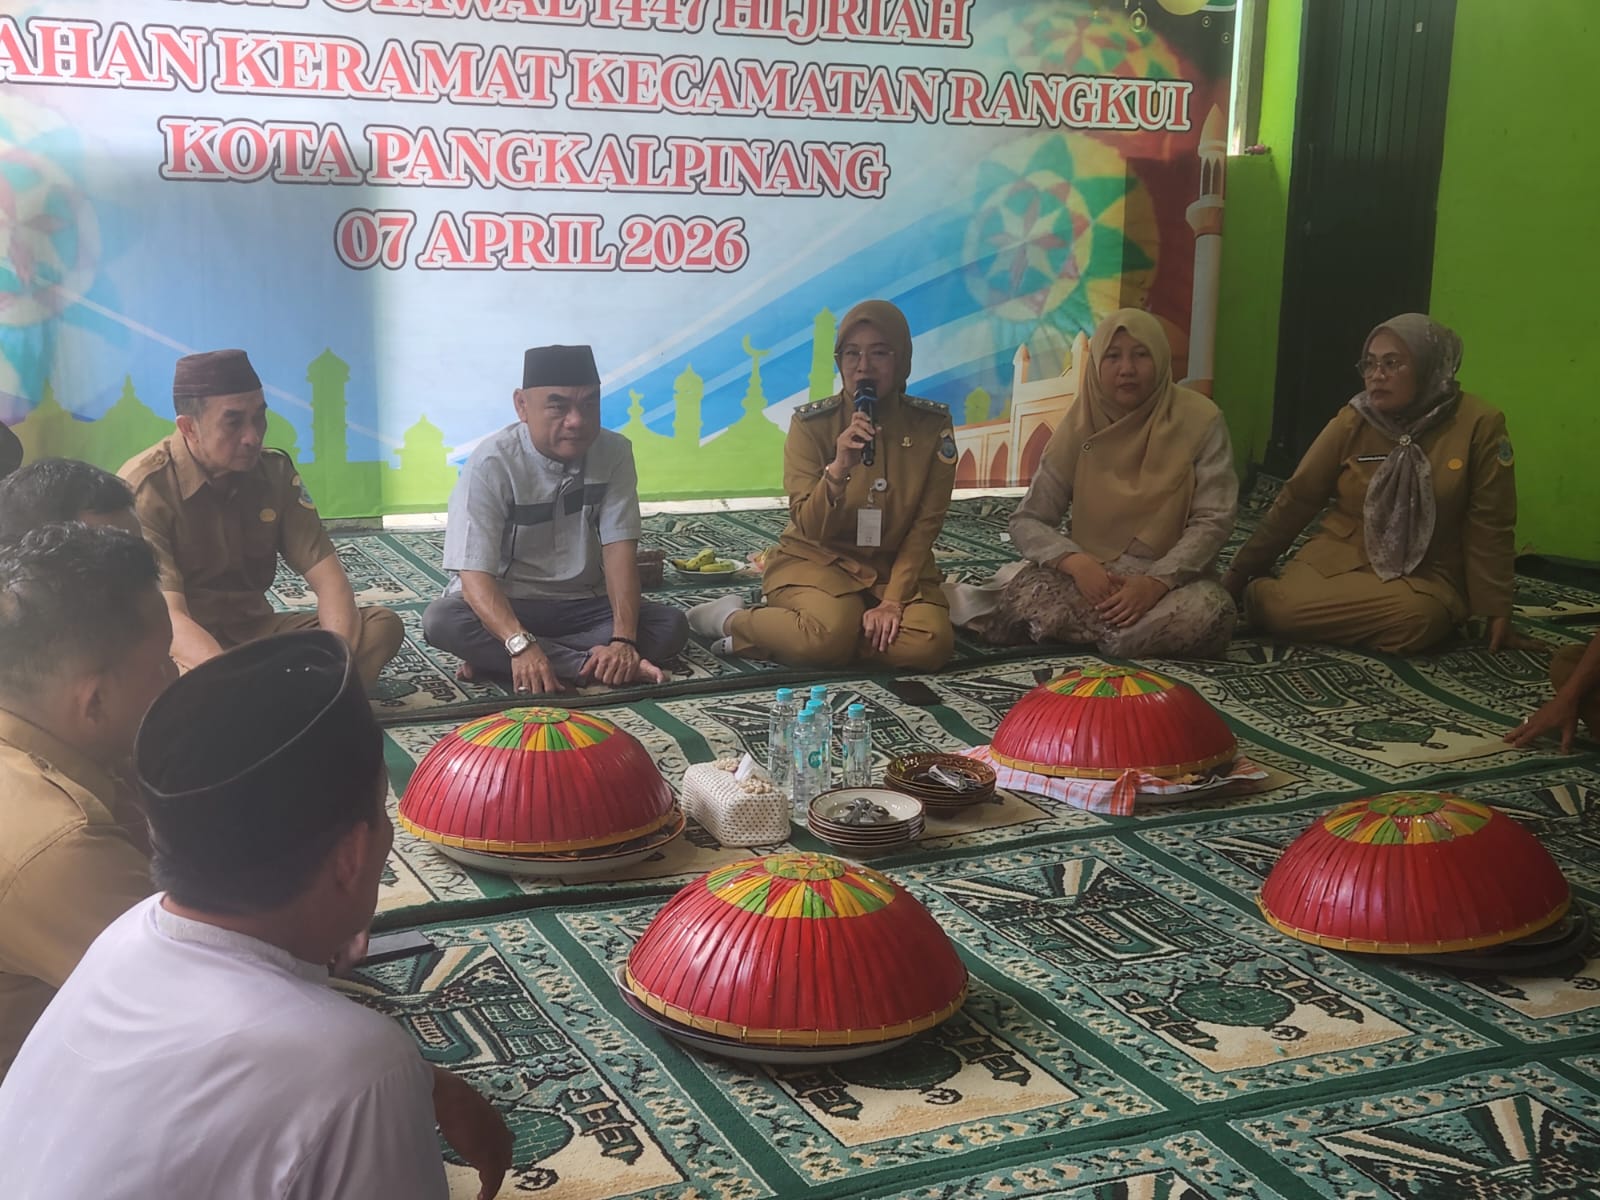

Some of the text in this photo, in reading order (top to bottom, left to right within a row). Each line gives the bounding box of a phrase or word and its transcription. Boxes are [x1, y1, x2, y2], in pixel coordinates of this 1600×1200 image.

[718, 0, 970, 44] HIJRIAH
[217, 32, 565, 105] KERAMAT
[571, 53, 941, 120] KECAMATAN
[949, 70, 1191, 131] RANGKUI
[163, 119, 889, 197] KOTA PANGKALPINANG
[338, 212, 747, 269] 07 APRIL 2026
